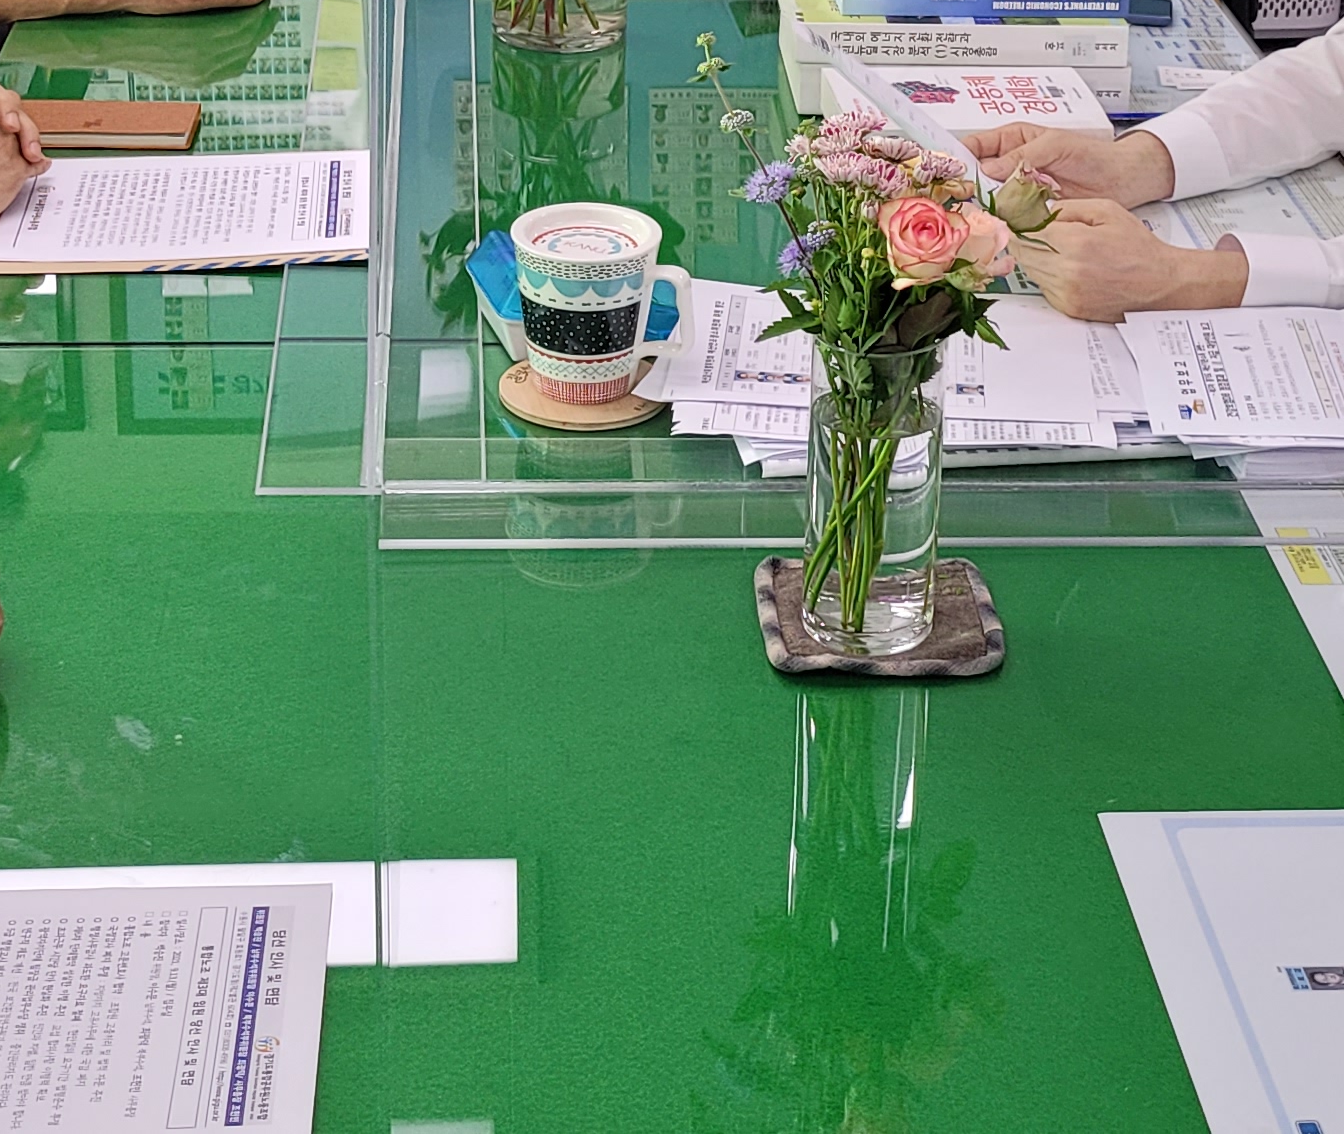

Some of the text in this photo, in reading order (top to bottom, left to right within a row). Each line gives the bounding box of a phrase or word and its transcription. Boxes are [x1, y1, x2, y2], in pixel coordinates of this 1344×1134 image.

[830, 30, 866, 43] 국내외
[870, 30, 905, 43] 에너지
[881, 45, 905, 57] 시장
[934, 44, 948, 59] (1)
[961, 75, 1015, 116] 공동체
[1004, 75, 1059, 116] 경제학
[198, 945, 214, 973] 통합노조
[264, 930, 286, 1005] 당선 인사 및 면담
[195, 977, 209, 996] 제3대
[191, 1000, 206, 1015] 임원
[188, 1019, 203, 1034] 당선
[185, 1039, 200, 1054] 인사
[183, 1058, 197, 1066] 및
[180, 1070, 195, 1085] 면담
